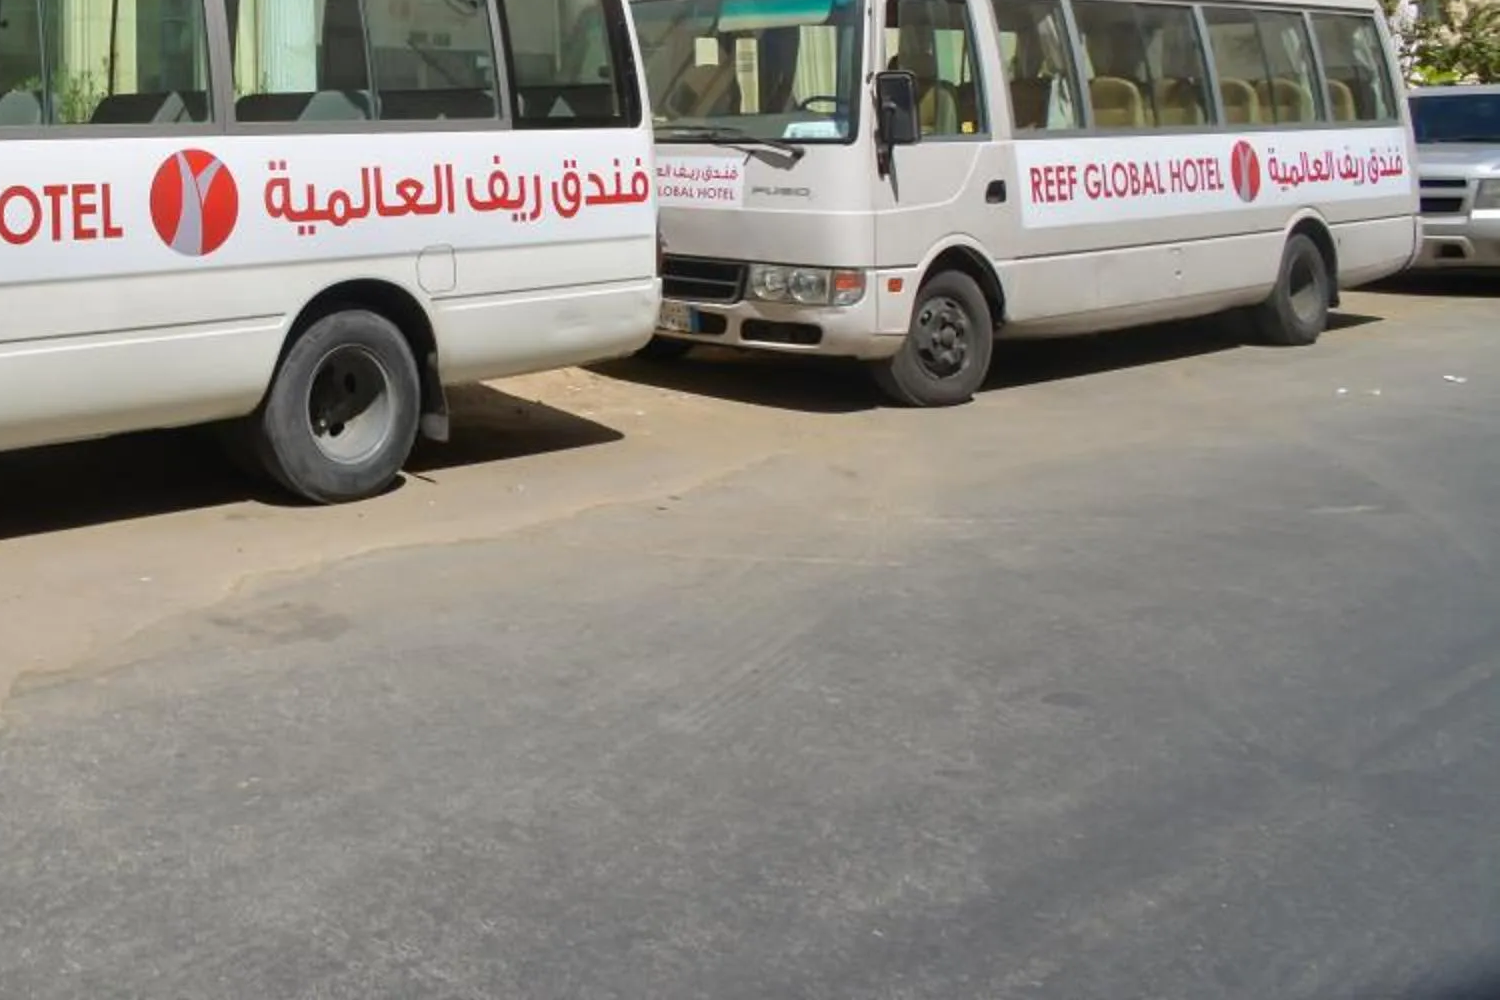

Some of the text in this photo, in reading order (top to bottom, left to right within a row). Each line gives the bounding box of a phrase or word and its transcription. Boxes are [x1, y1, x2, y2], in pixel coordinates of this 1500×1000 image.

[701, 164, 739, 181] فندق
[1030, 157, 1224, 203] REEF GLOBAL HOTEL
[1268, 145, 1403, 192] فندق ريف العالمية
[263, 155, 649, 236] فندق ريف العالمية
[657, 186, 735, 200] LOBAL HOTEL
